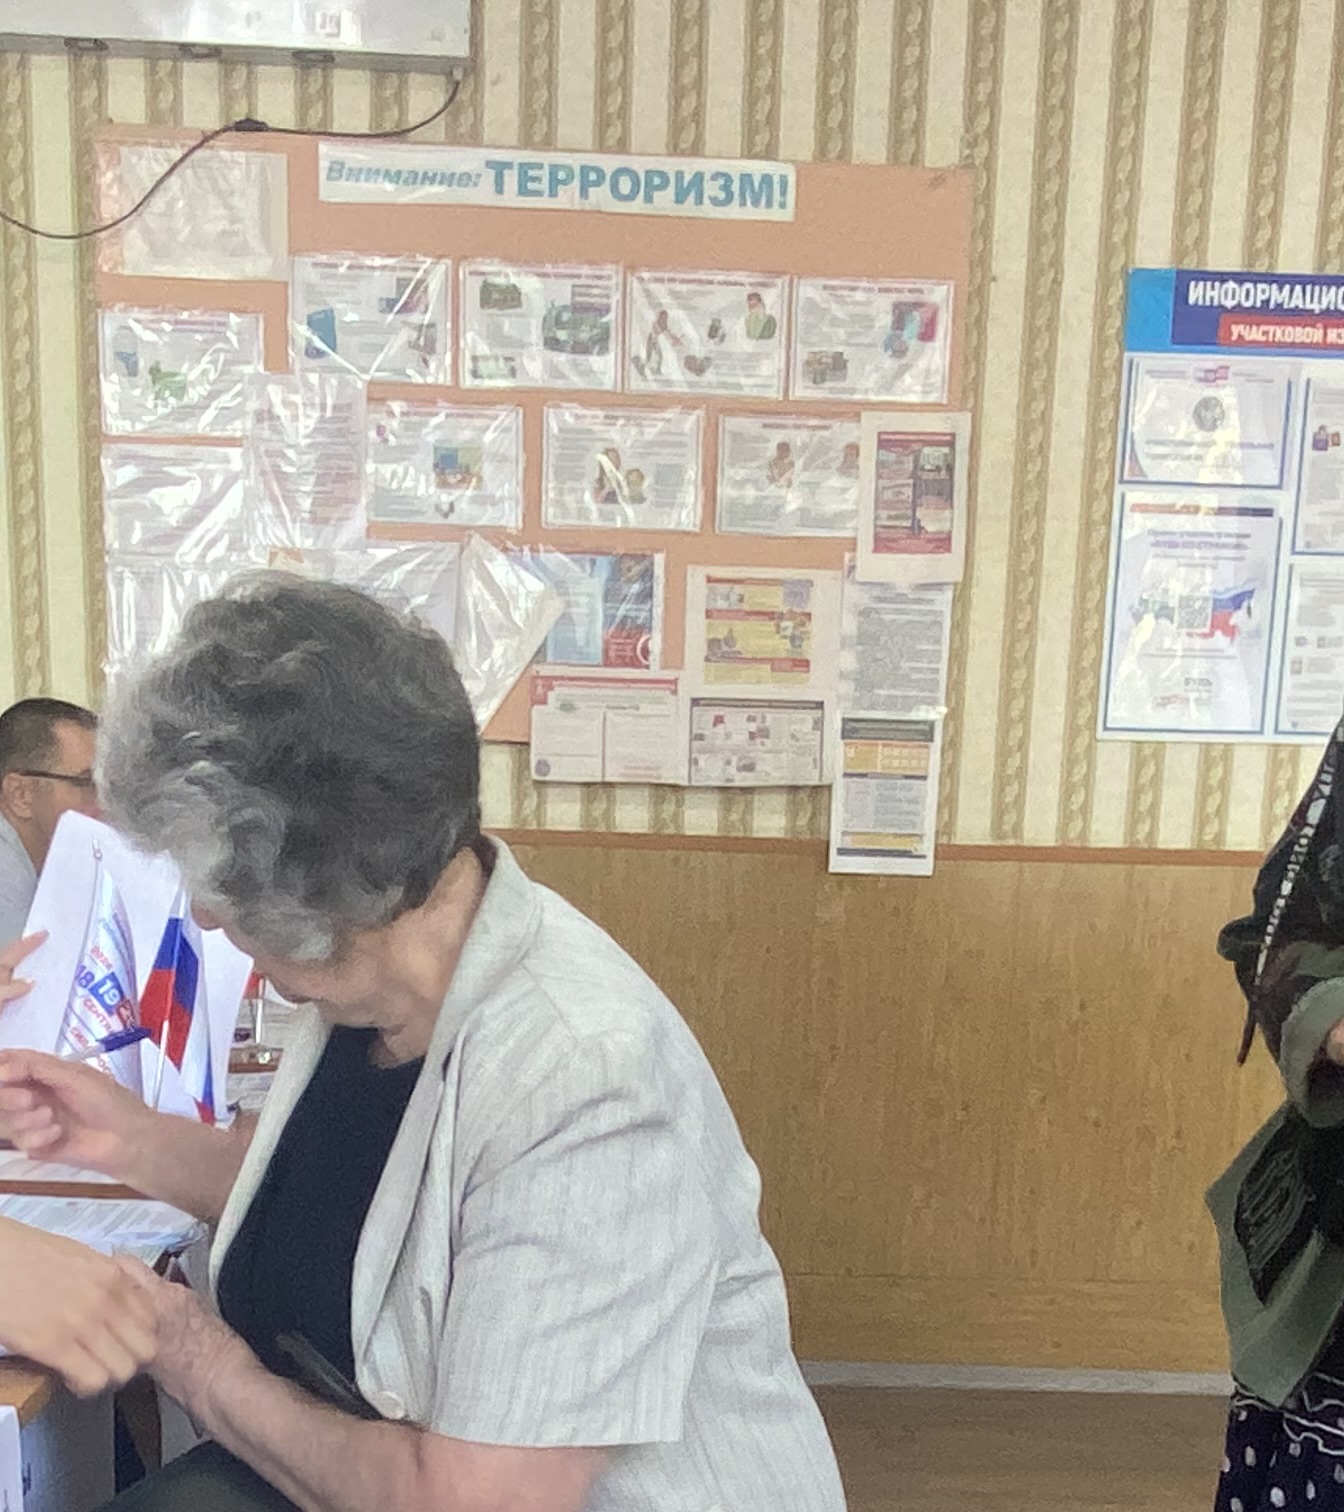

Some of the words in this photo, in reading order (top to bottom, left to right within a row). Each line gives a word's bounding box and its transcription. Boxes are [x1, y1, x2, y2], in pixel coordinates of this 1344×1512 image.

[485, 160, 789, 209] ТЕРРОРИЗМ!
[1230, 323, 1323, 344] УЧАСТКОВОЙ
[98, 978, 122, 1006] 19
